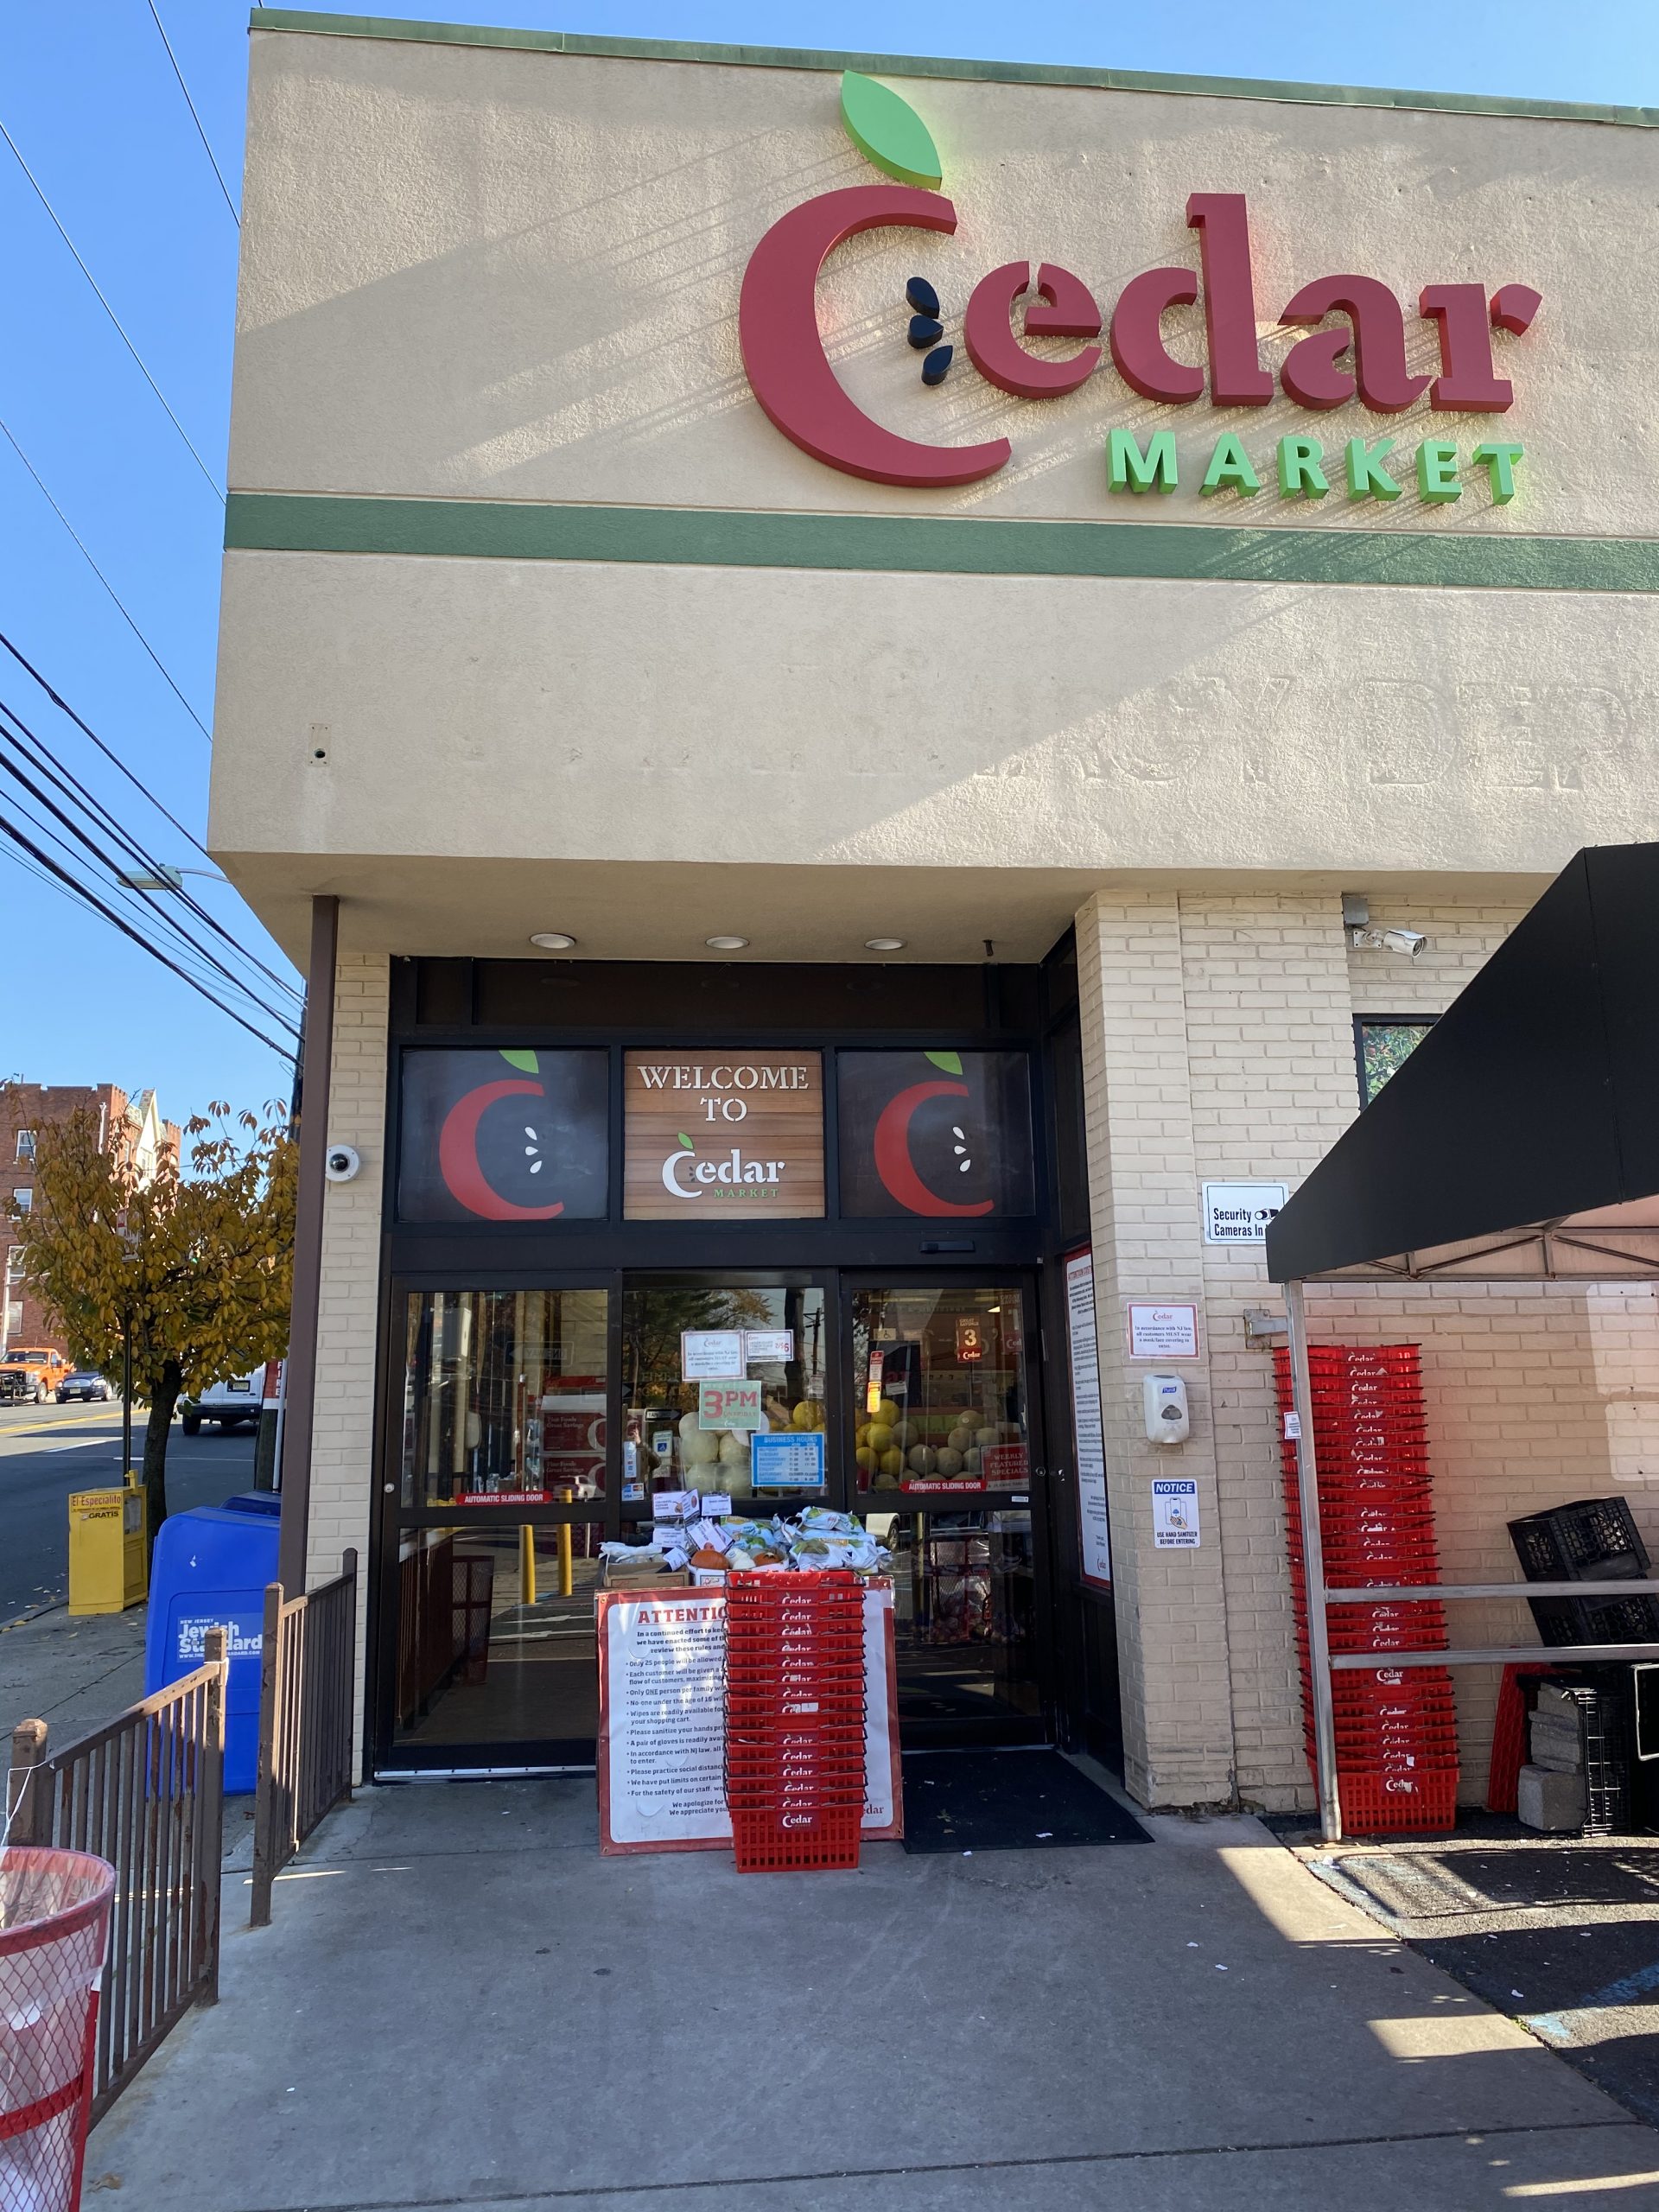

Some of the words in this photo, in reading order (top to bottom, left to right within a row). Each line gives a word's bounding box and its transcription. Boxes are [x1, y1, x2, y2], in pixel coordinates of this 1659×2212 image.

[740, 184, 1542, 487] Cedar
[1105, 429, 1524, 505] MARKET
[638, 1066, 810, 1090] WELCOME
[699, 1097, 747, 1122] TO
[662, 1148, 785, 1198] Cedar
[714, 1188, 779, 1198] MARKET
[1214, 1208, 1251, 1223] Security
[1214, 1224, 1252, 1236] Cameras
[1255, 1224, 1263, 1236] In
[1153, 1313, 1173, 1321] Cedar
[964, 1329, 976, 1346] 3
[908, 1482, 941, 1491] AUTOMATIC
[964, 1481, 982, 1490] DOOR
[1156, 1483, 1193, 1493] NOTICE
[72, 1497, 79, 1506] El
[81, 1495, 121, 1507] Especialito
[500, 1494, 525, 1503] SLIDING
[525, 1493, 543, 1502] DOOR
[89, 1510, 119, 1519] GRATIS
[1376, 1669, 1403, 1681] Cedar
[654, 1788, 675, 1796] safety
[864, 1804, 884, 1815] edar
[782, 1815, 812, 1828] Cedar
